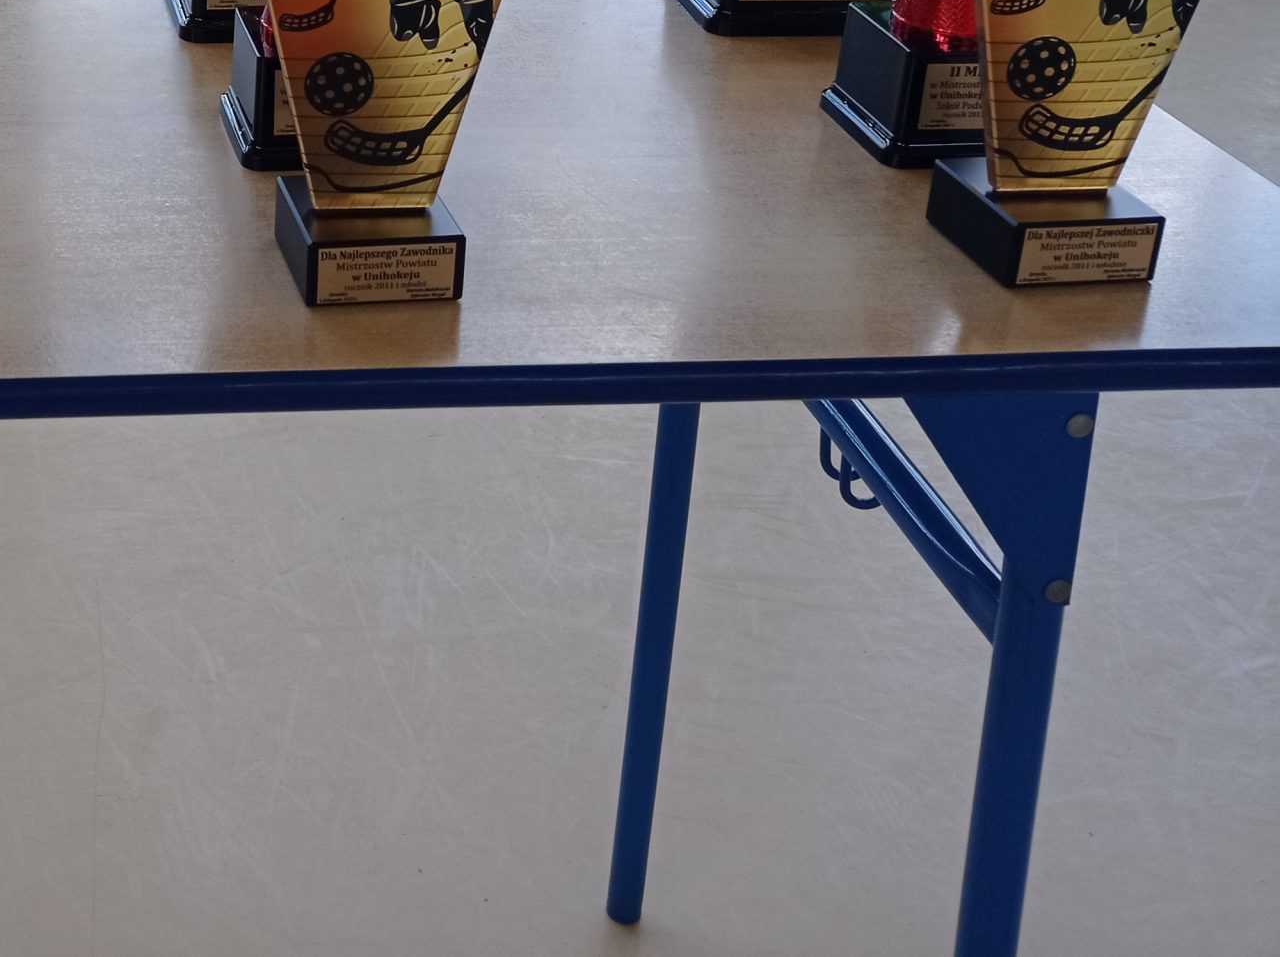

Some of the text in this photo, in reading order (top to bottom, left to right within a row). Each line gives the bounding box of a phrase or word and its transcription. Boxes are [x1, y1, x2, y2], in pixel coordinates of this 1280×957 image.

[1027, 226, 1155, 243] Dla Najlepszej Zawodniczki
[1040, 240, 1137, 252] Mistrzostw Powiatu
[320, 246, 454, 263] Dla Najlepszego Zawodnika
[1065, 251, 1119, 262] Unihokeju
[336, 259, 438, 273] Mistrzostw Powiatu
[351, 271, 421, 282] w Unihokeju
[344, 282, 373, 292] rocznik
